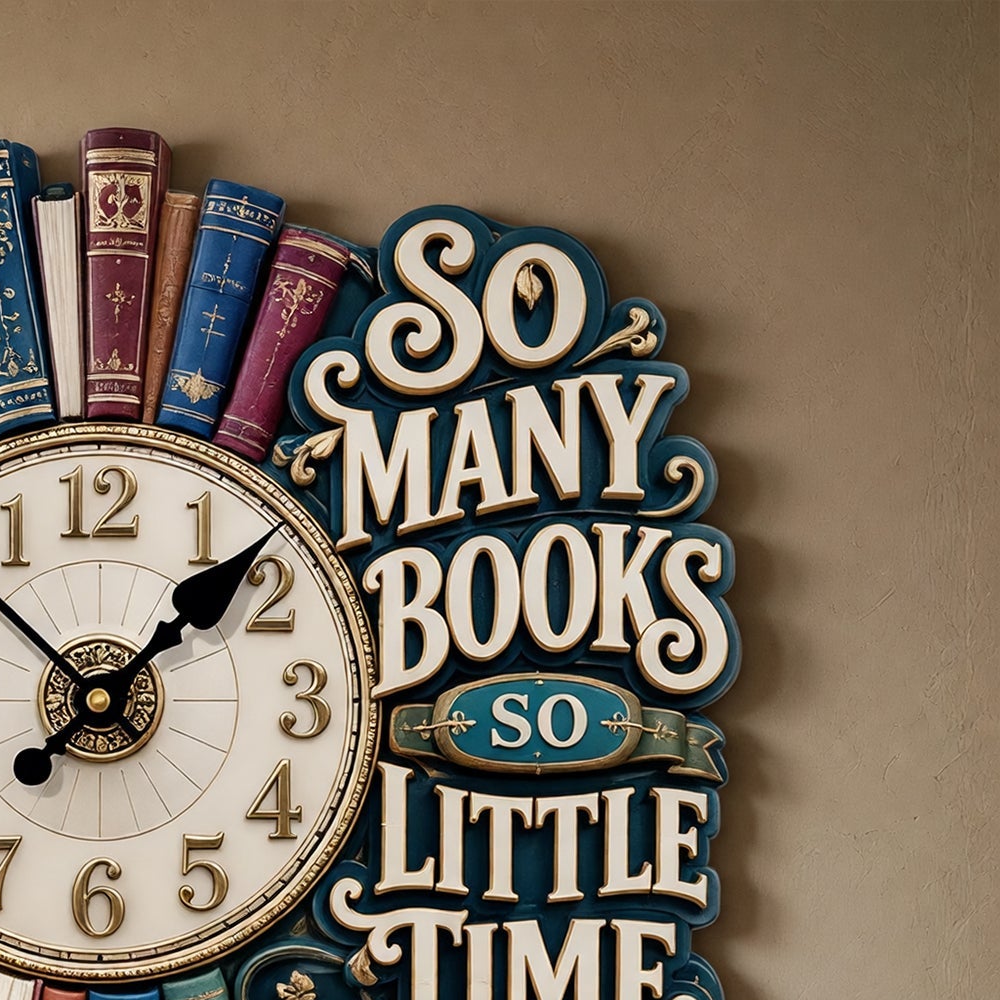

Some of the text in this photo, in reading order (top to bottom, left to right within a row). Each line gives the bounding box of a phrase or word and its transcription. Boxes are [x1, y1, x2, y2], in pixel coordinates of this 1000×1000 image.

[365, 219, 587, 394] SO
[304, 350, 675, 551] MANY
[59, 464, 140, 538] 12
[187, 491, 219, 565] 1
[246, 555, 296, 632] 2
[363, 523, 729, 698] BOOKS
[279, 659, 331, 739] 3
[491, 694, 588, 748] SO
[246, 758, 302, 839] 4
[374, 761, 707, 907] LITTLE
[71, 857, 126, 938] 6
[178, 831, 229, 911] 5
